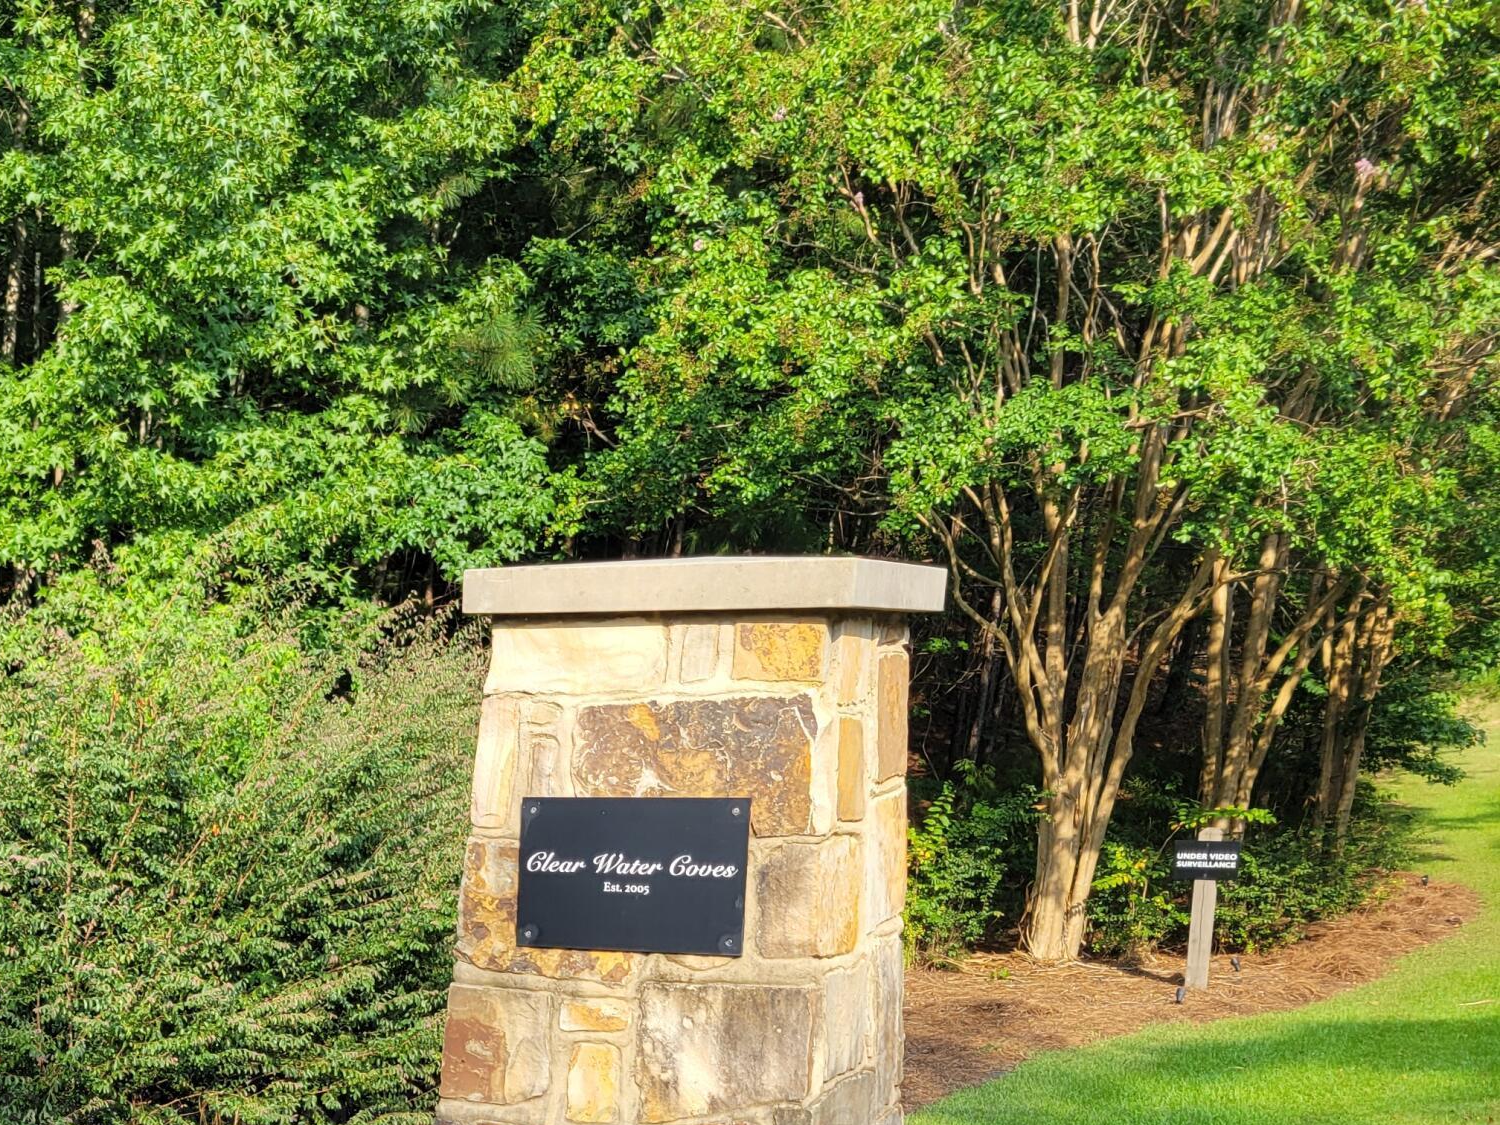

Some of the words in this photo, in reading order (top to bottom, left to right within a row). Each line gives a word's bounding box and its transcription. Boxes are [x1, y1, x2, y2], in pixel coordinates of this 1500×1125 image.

[1176, 852, 1208, 860] UNDER
[526, 851, 587, 873] Clear
[593, 853, 663, 876] Water
[669, 855, 739, 878] Coves
[1176, 860, 1236, 868] SURVEILLANCE
[603, 881, 622, 893] Est.
[624, 883, 650, 895] 2005
